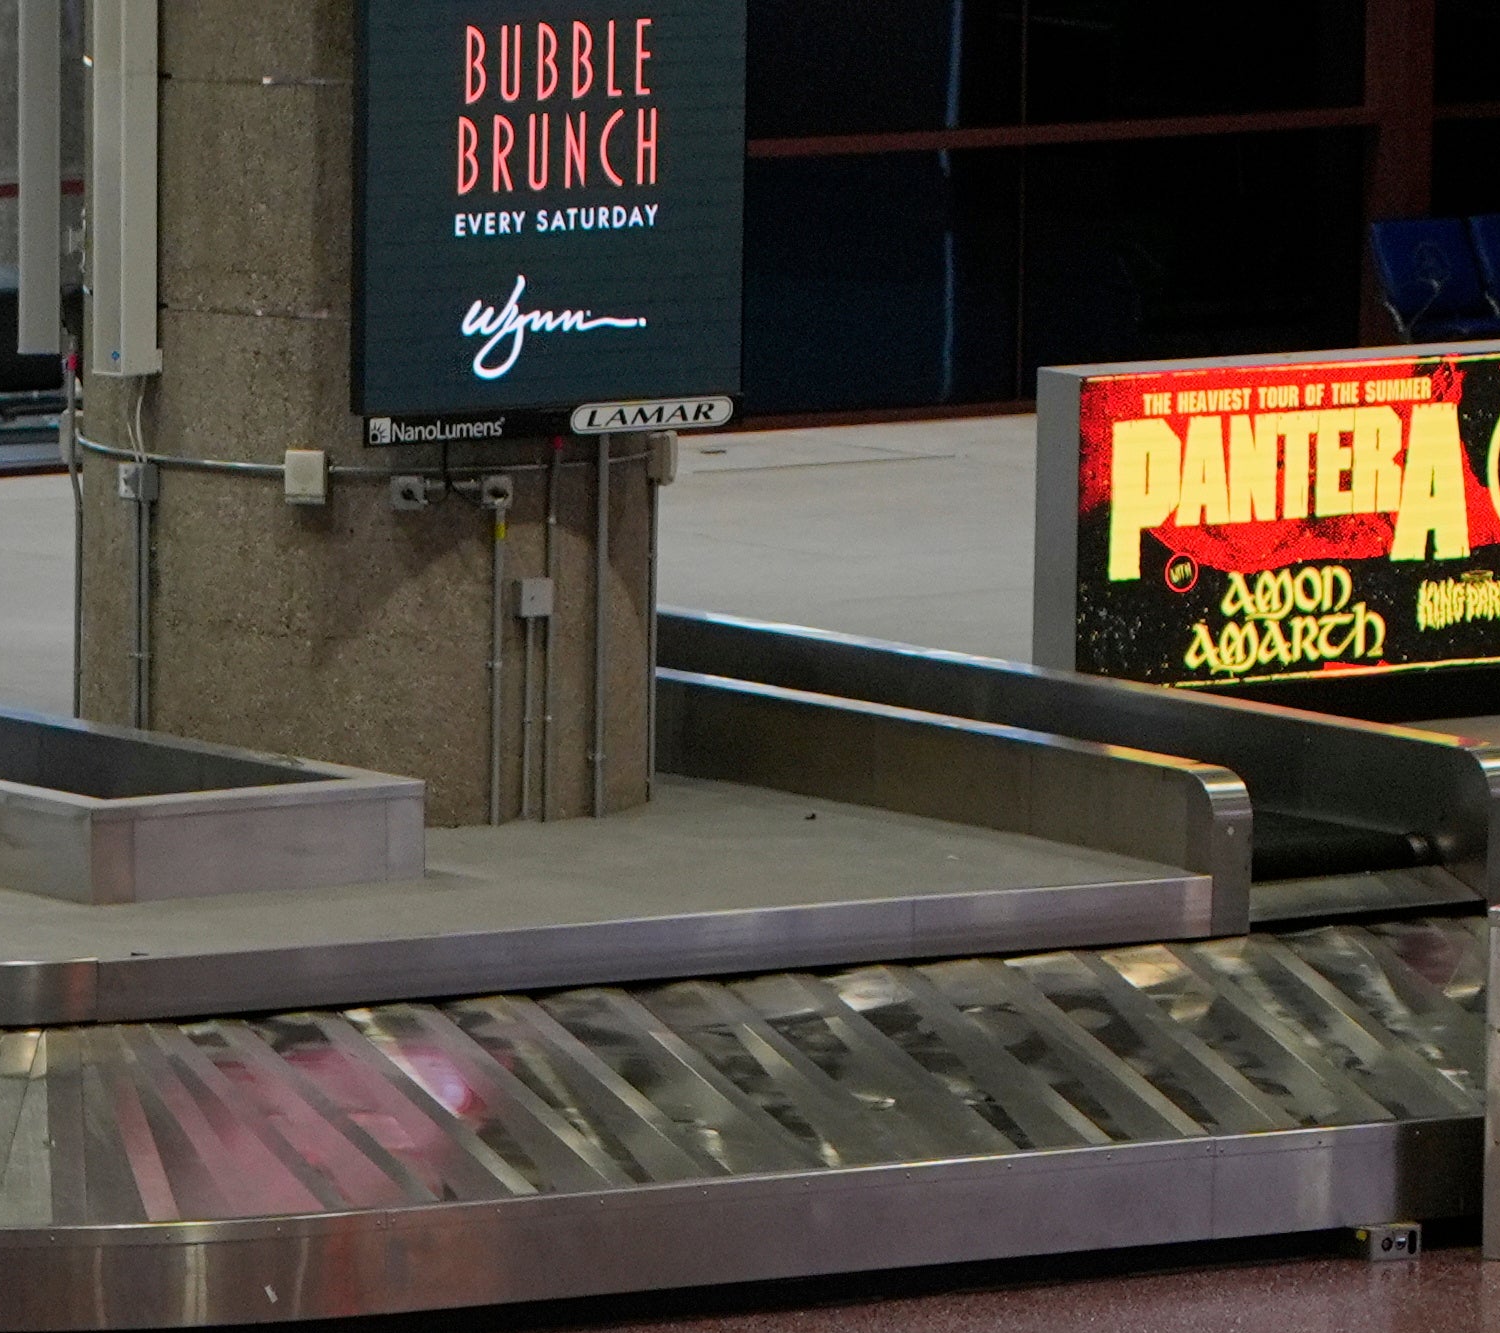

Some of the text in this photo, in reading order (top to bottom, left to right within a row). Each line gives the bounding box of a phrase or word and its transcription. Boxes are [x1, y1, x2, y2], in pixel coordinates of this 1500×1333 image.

[464, 18, 653, 104] BUBBLE
[457, 107, 658, 195] BRUNCH
[454, 203, 659, 237] EVERY SATURDAY
[586, 402, 714, 428] LAMAR
[1143, 376, 1432, 416] THE HEAVIEST TOUR OF THE SUMMER
[1108, 401, 1471, 583] PANTERA
